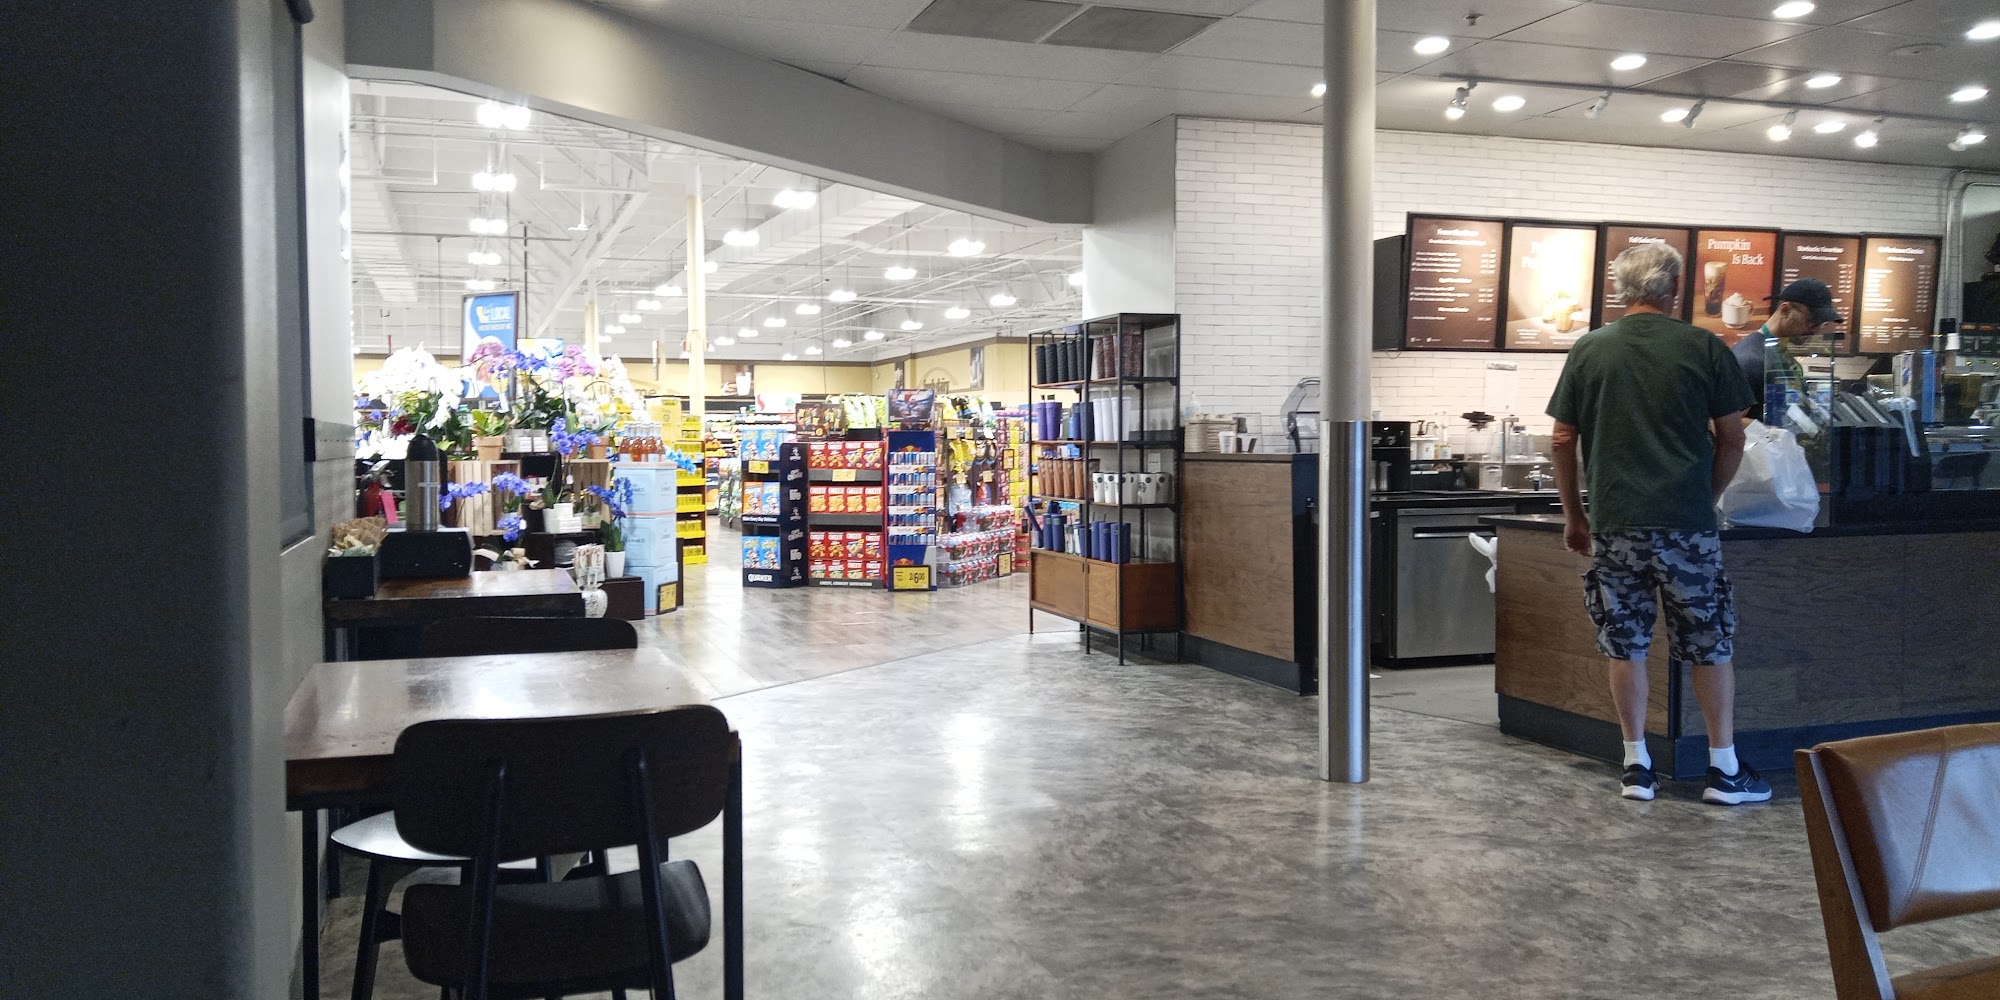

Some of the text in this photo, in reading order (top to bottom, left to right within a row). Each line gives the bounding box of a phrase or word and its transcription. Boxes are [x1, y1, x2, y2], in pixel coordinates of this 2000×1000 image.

[1707, 239, 1751, 252] Pumpkin
[1732, 253, 1764, 265] Is Back
[491, 306, 511, 320] LOCAL
[789, 489, 801, 500] life
[790, 549, 802, 560] life
[748, 574, 773, 582] QUAKER
